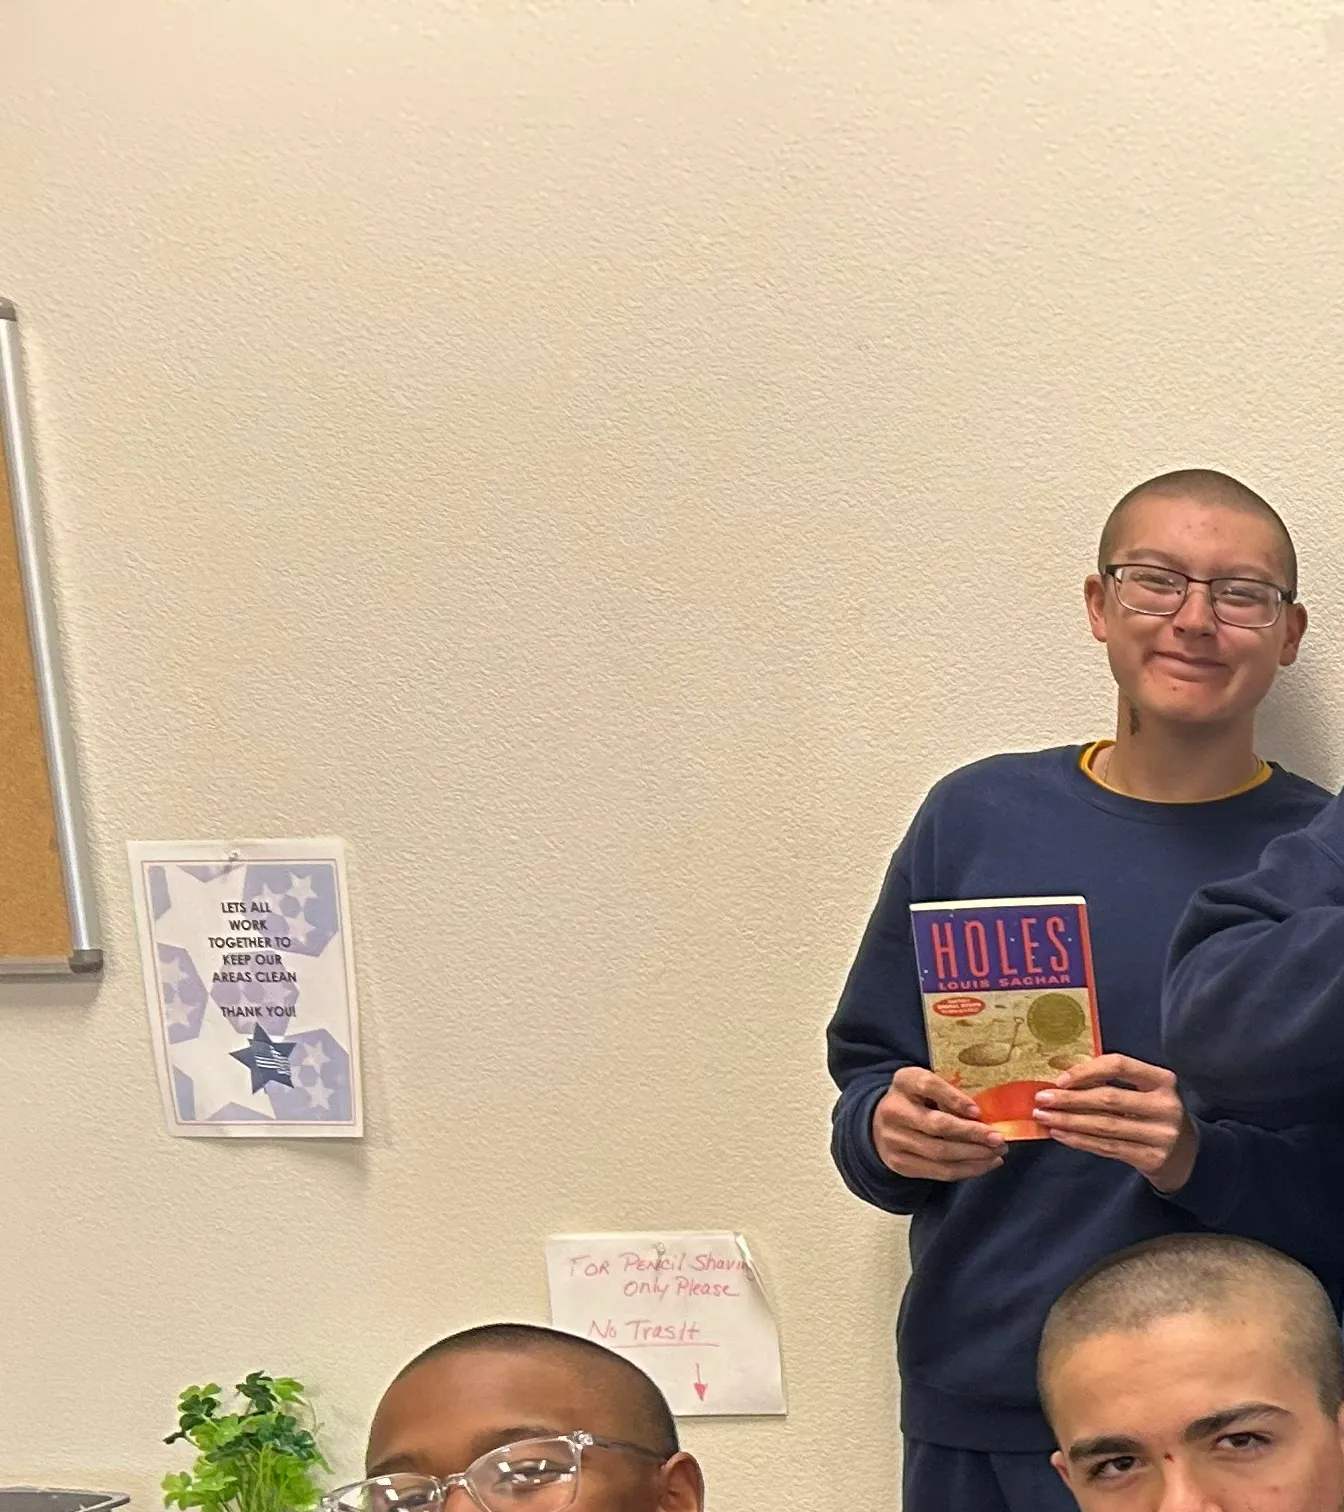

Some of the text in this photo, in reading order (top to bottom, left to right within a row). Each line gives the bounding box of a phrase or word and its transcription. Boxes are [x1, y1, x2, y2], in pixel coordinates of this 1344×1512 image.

[221, 901, 272, 914] LETS ALL
[229, 919, 268, 931] WORK
[208, 936, 291, 949] TOGETHER TO
[931, 916, 1069, 980] HOLES
[222, 954, 282, 966] KEEP OUR
[212, 971, 297, 983] AREAS CLEAN
[938, 973, 1071, 991] LOUIS SACHAR
[221, 1006, 297, 1018] THANK YOU!
[675, 1276, 740, 1297] Please
[587, 1319, 617, 1339] No
